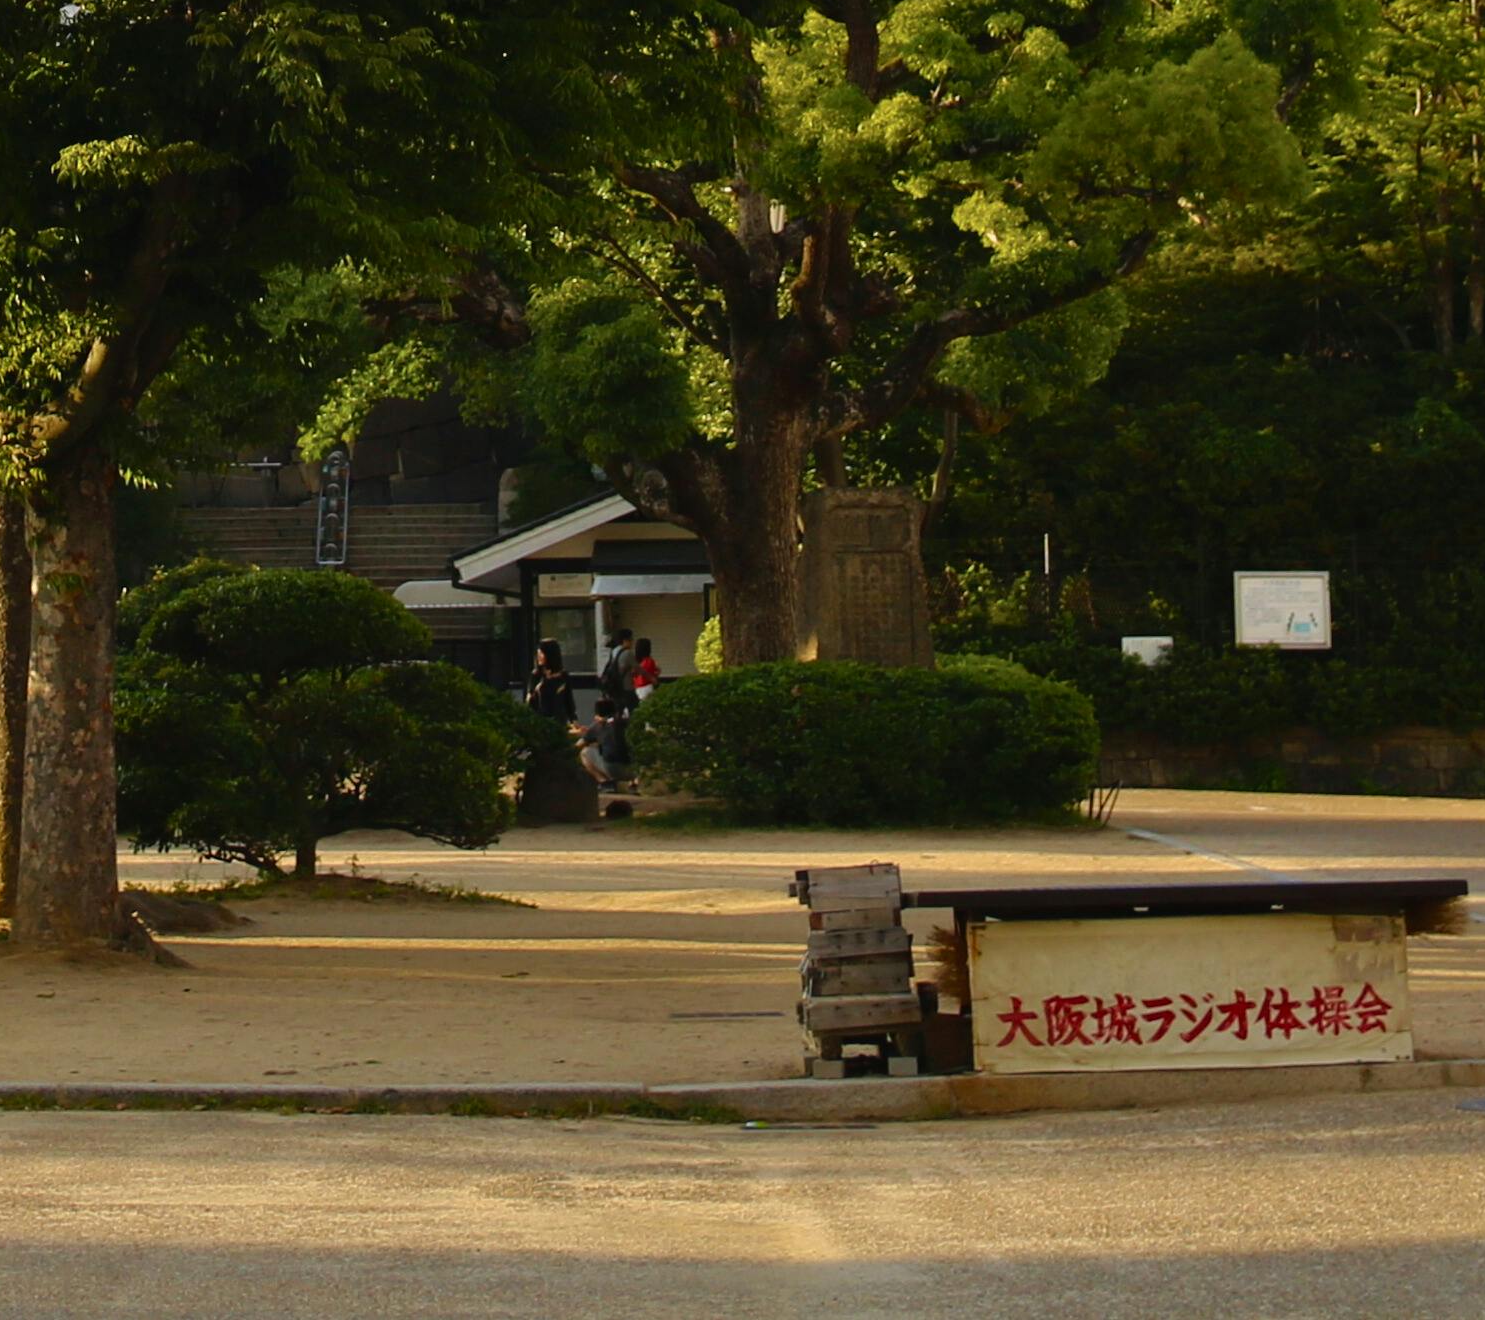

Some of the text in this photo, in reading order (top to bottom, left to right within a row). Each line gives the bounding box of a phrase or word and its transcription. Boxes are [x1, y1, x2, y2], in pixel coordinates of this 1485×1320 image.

[996, 982, 1393, 1048] 大阪城ラジオ体操会
